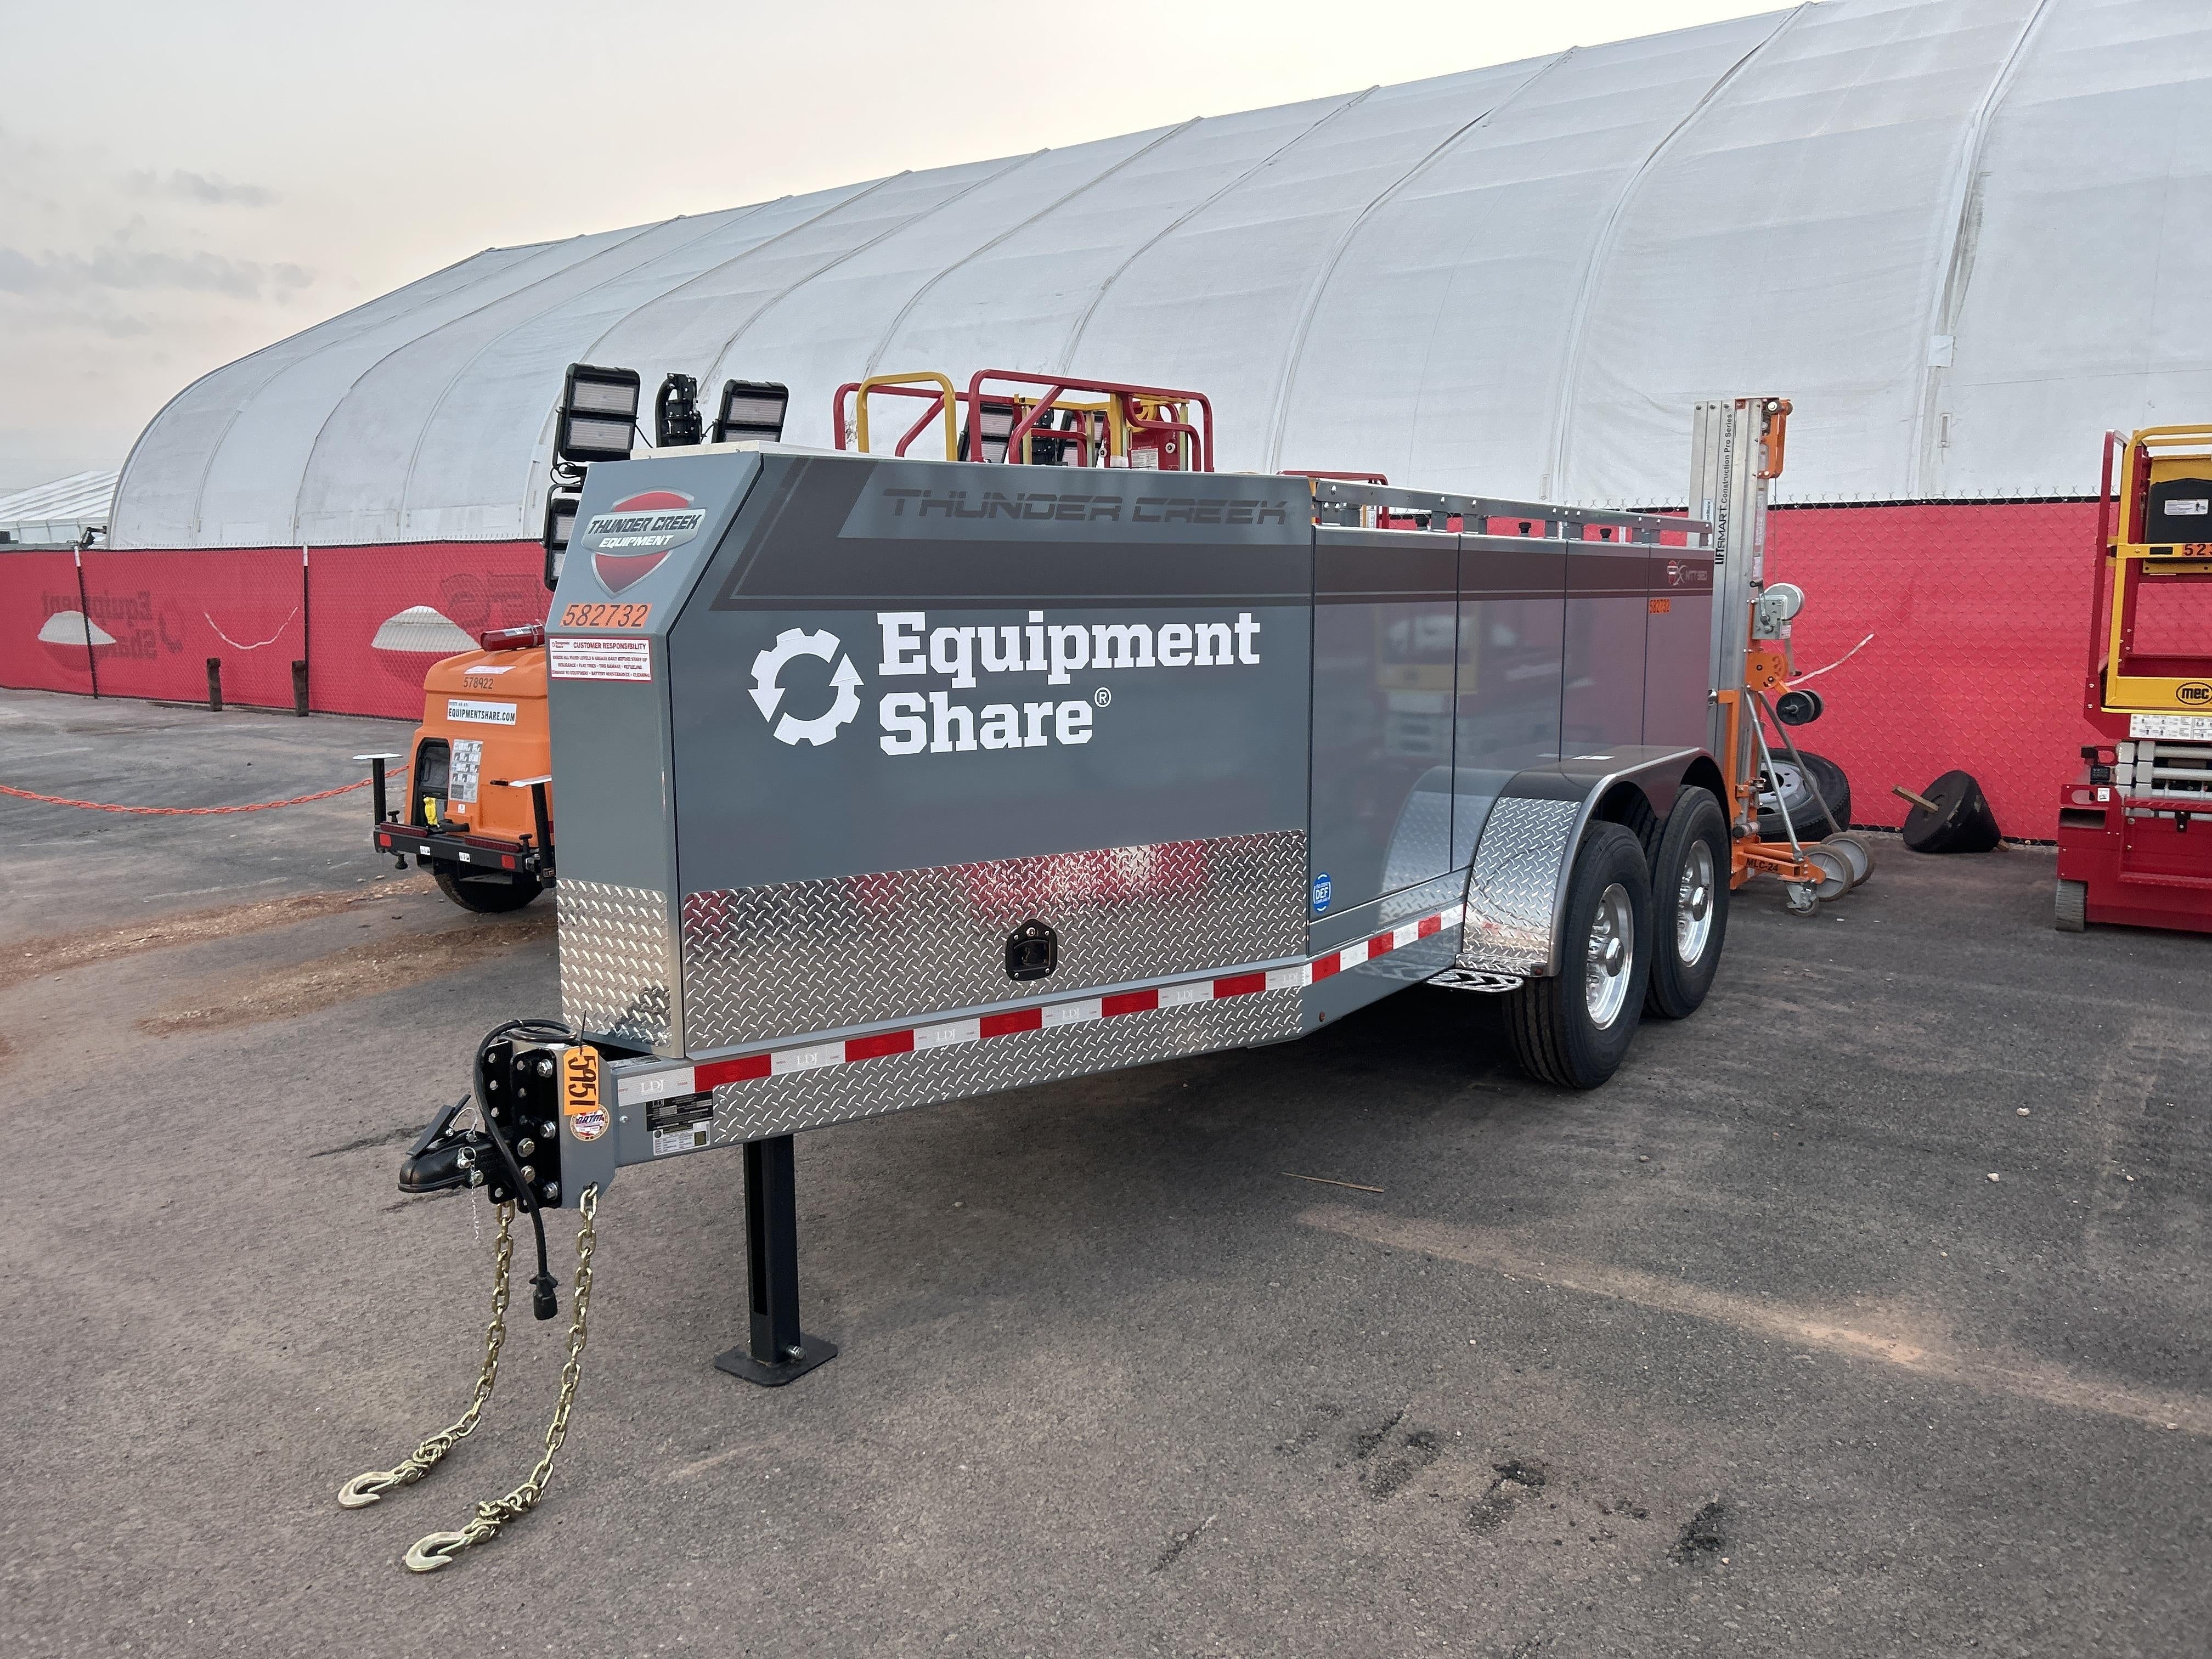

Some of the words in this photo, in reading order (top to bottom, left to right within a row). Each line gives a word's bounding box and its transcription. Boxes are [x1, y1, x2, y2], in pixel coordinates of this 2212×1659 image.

[1724, 414, 1733, 437] Series
[1722, 455, 1730, 503] Construction
[883, 488, 1122, 521] THUNDER
[1132, 497, 1289, 524] CREEK
[588, 517, 653, 534] THUNDER
[651, 515, 702, 531] CREEK
[1714, 505, 1728, 565] LIFTSMART
[599, 535, 674, 548] EQUIPMENT
[563, 604, 648, 627] 582732
[877, 611, 1261, 689] Equipment
[463, 677, 494, 690] 578922
[448, 708, 515, 721] EQUIPMENTSHARE.COM
[1746, 857, 1779, 871] MLC-24
[1315, 886, 1329, 900] DEF
[567, 1056, 596, 1106] 5951
